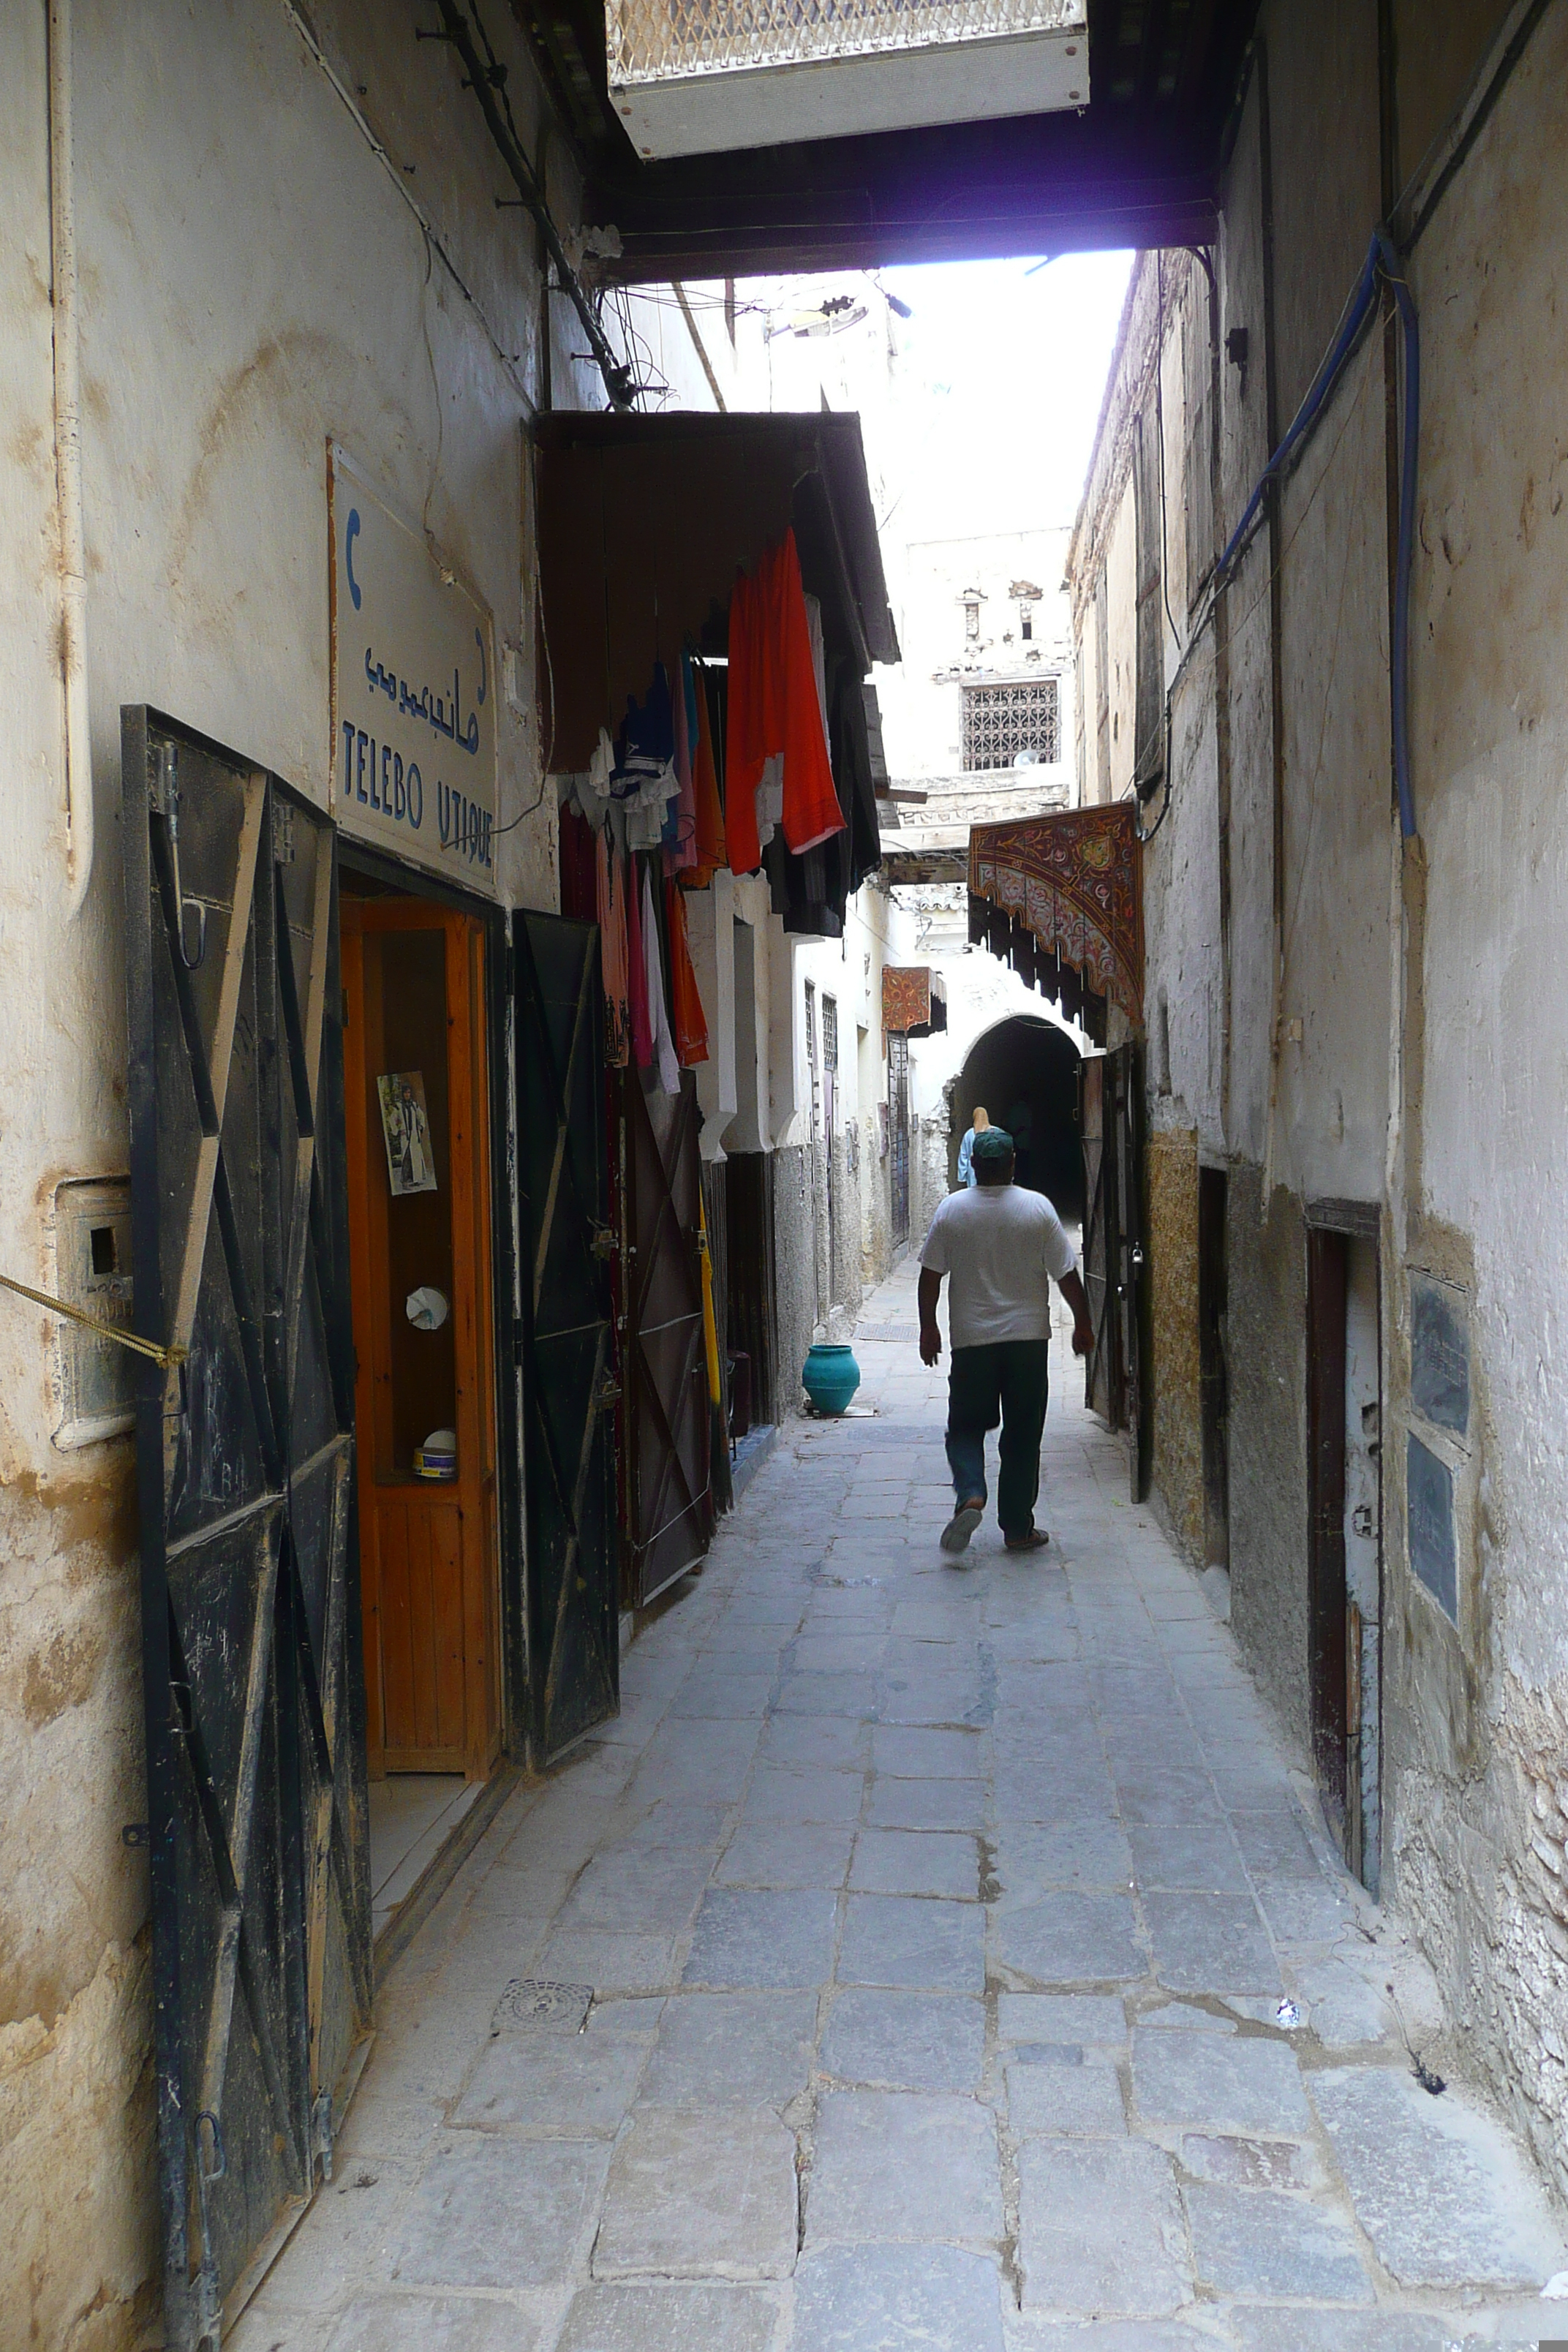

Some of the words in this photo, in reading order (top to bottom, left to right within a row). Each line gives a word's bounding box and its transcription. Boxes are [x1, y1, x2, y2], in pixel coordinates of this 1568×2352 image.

[365, 647, 429, 720] عمومي
[342, 720, 423, 830] TELEBO
[437, 780, 493, 869] UTIQUE
